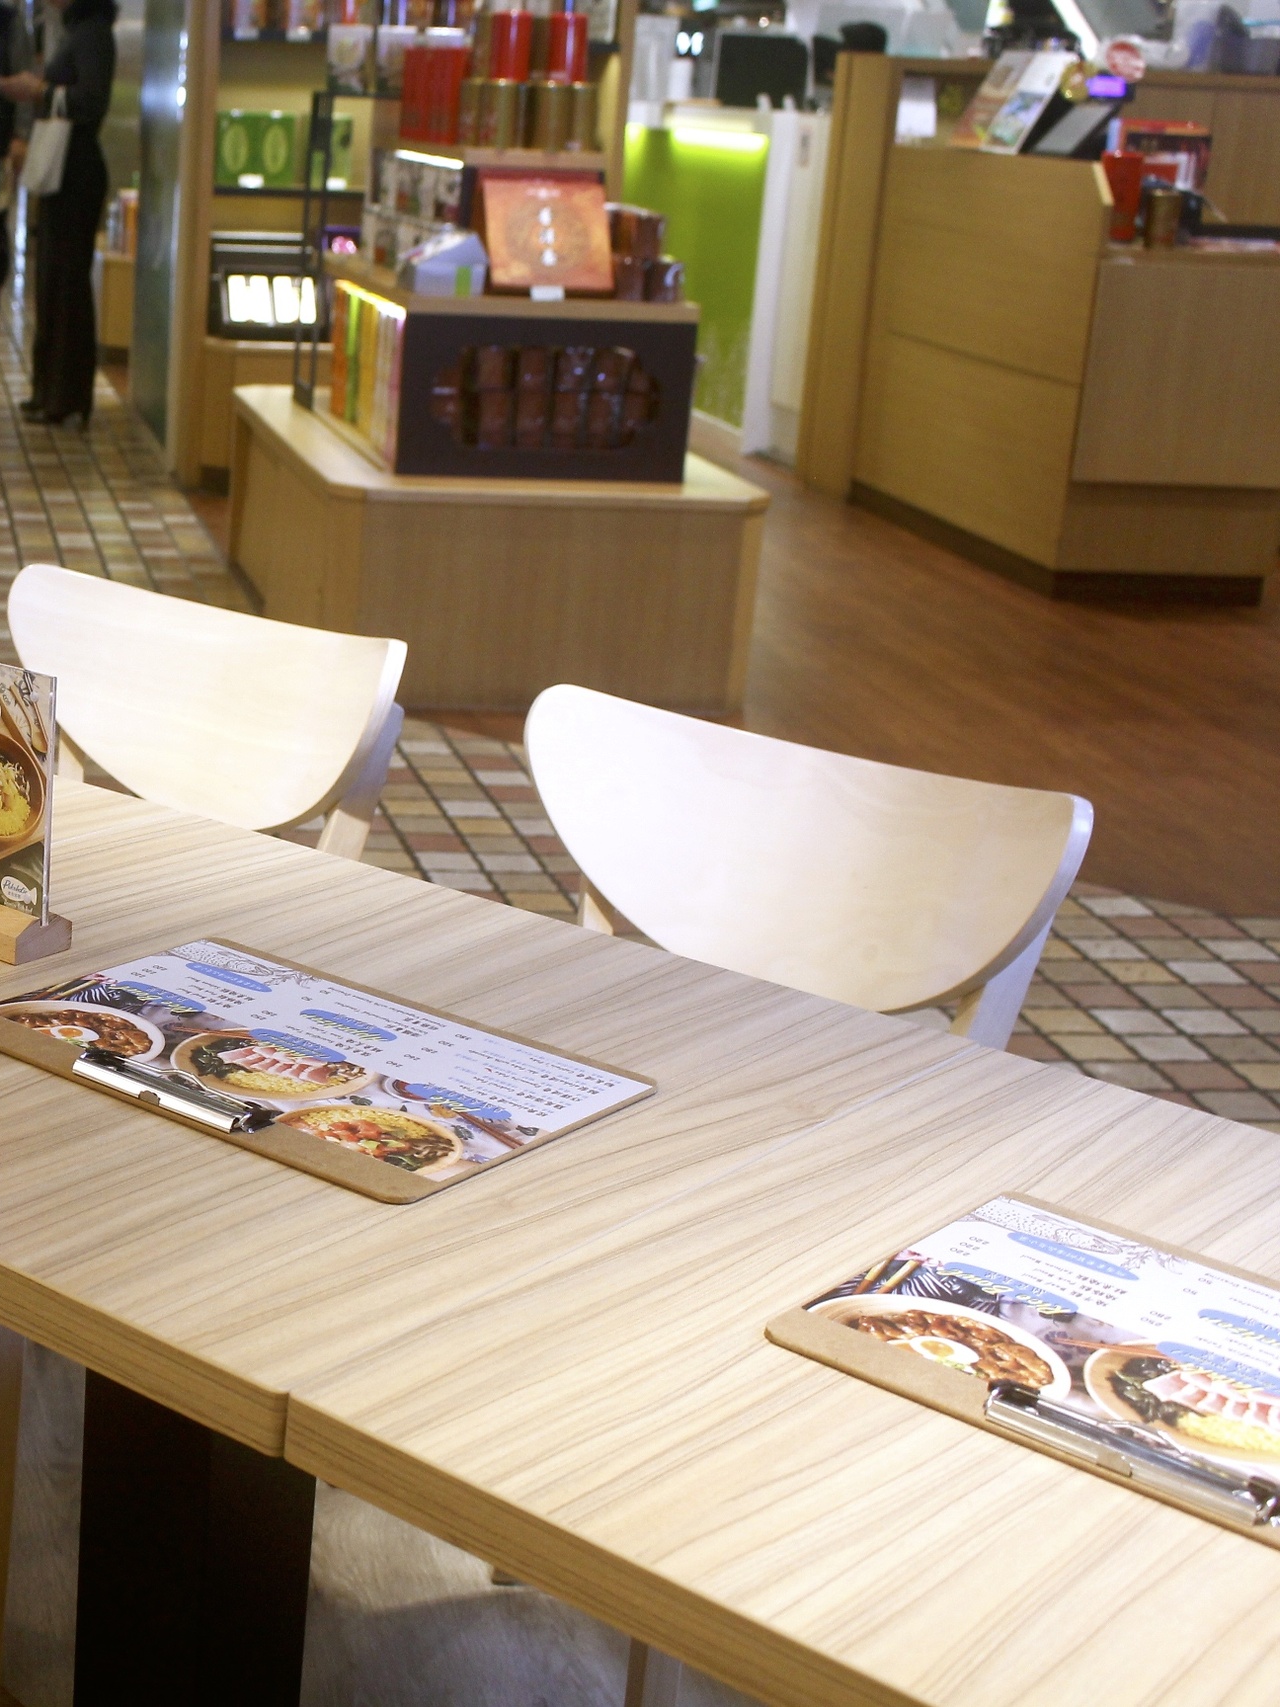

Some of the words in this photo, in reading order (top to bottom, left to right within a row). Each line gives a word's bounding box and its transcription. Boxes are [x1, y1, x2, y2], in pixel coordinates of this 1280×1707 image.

[969, 1237, 990, 1245] 220
[959, 1242, 980, 1251] 220
[949, 1248, 971, 1256] 220
[1020, 1255, 1042, 1264] Bowl
[1033, 1269, 1054, 1277] Bowl
[935, 1268, 1012, 1295] Bowl
[1021, 1274, 1043, 1282] Bowl
[1015, 1294, 1070, 1315] Rice
[1148, 1311, 1173, 1320] 280
[1139, 1317, 1163, 1326] 250
